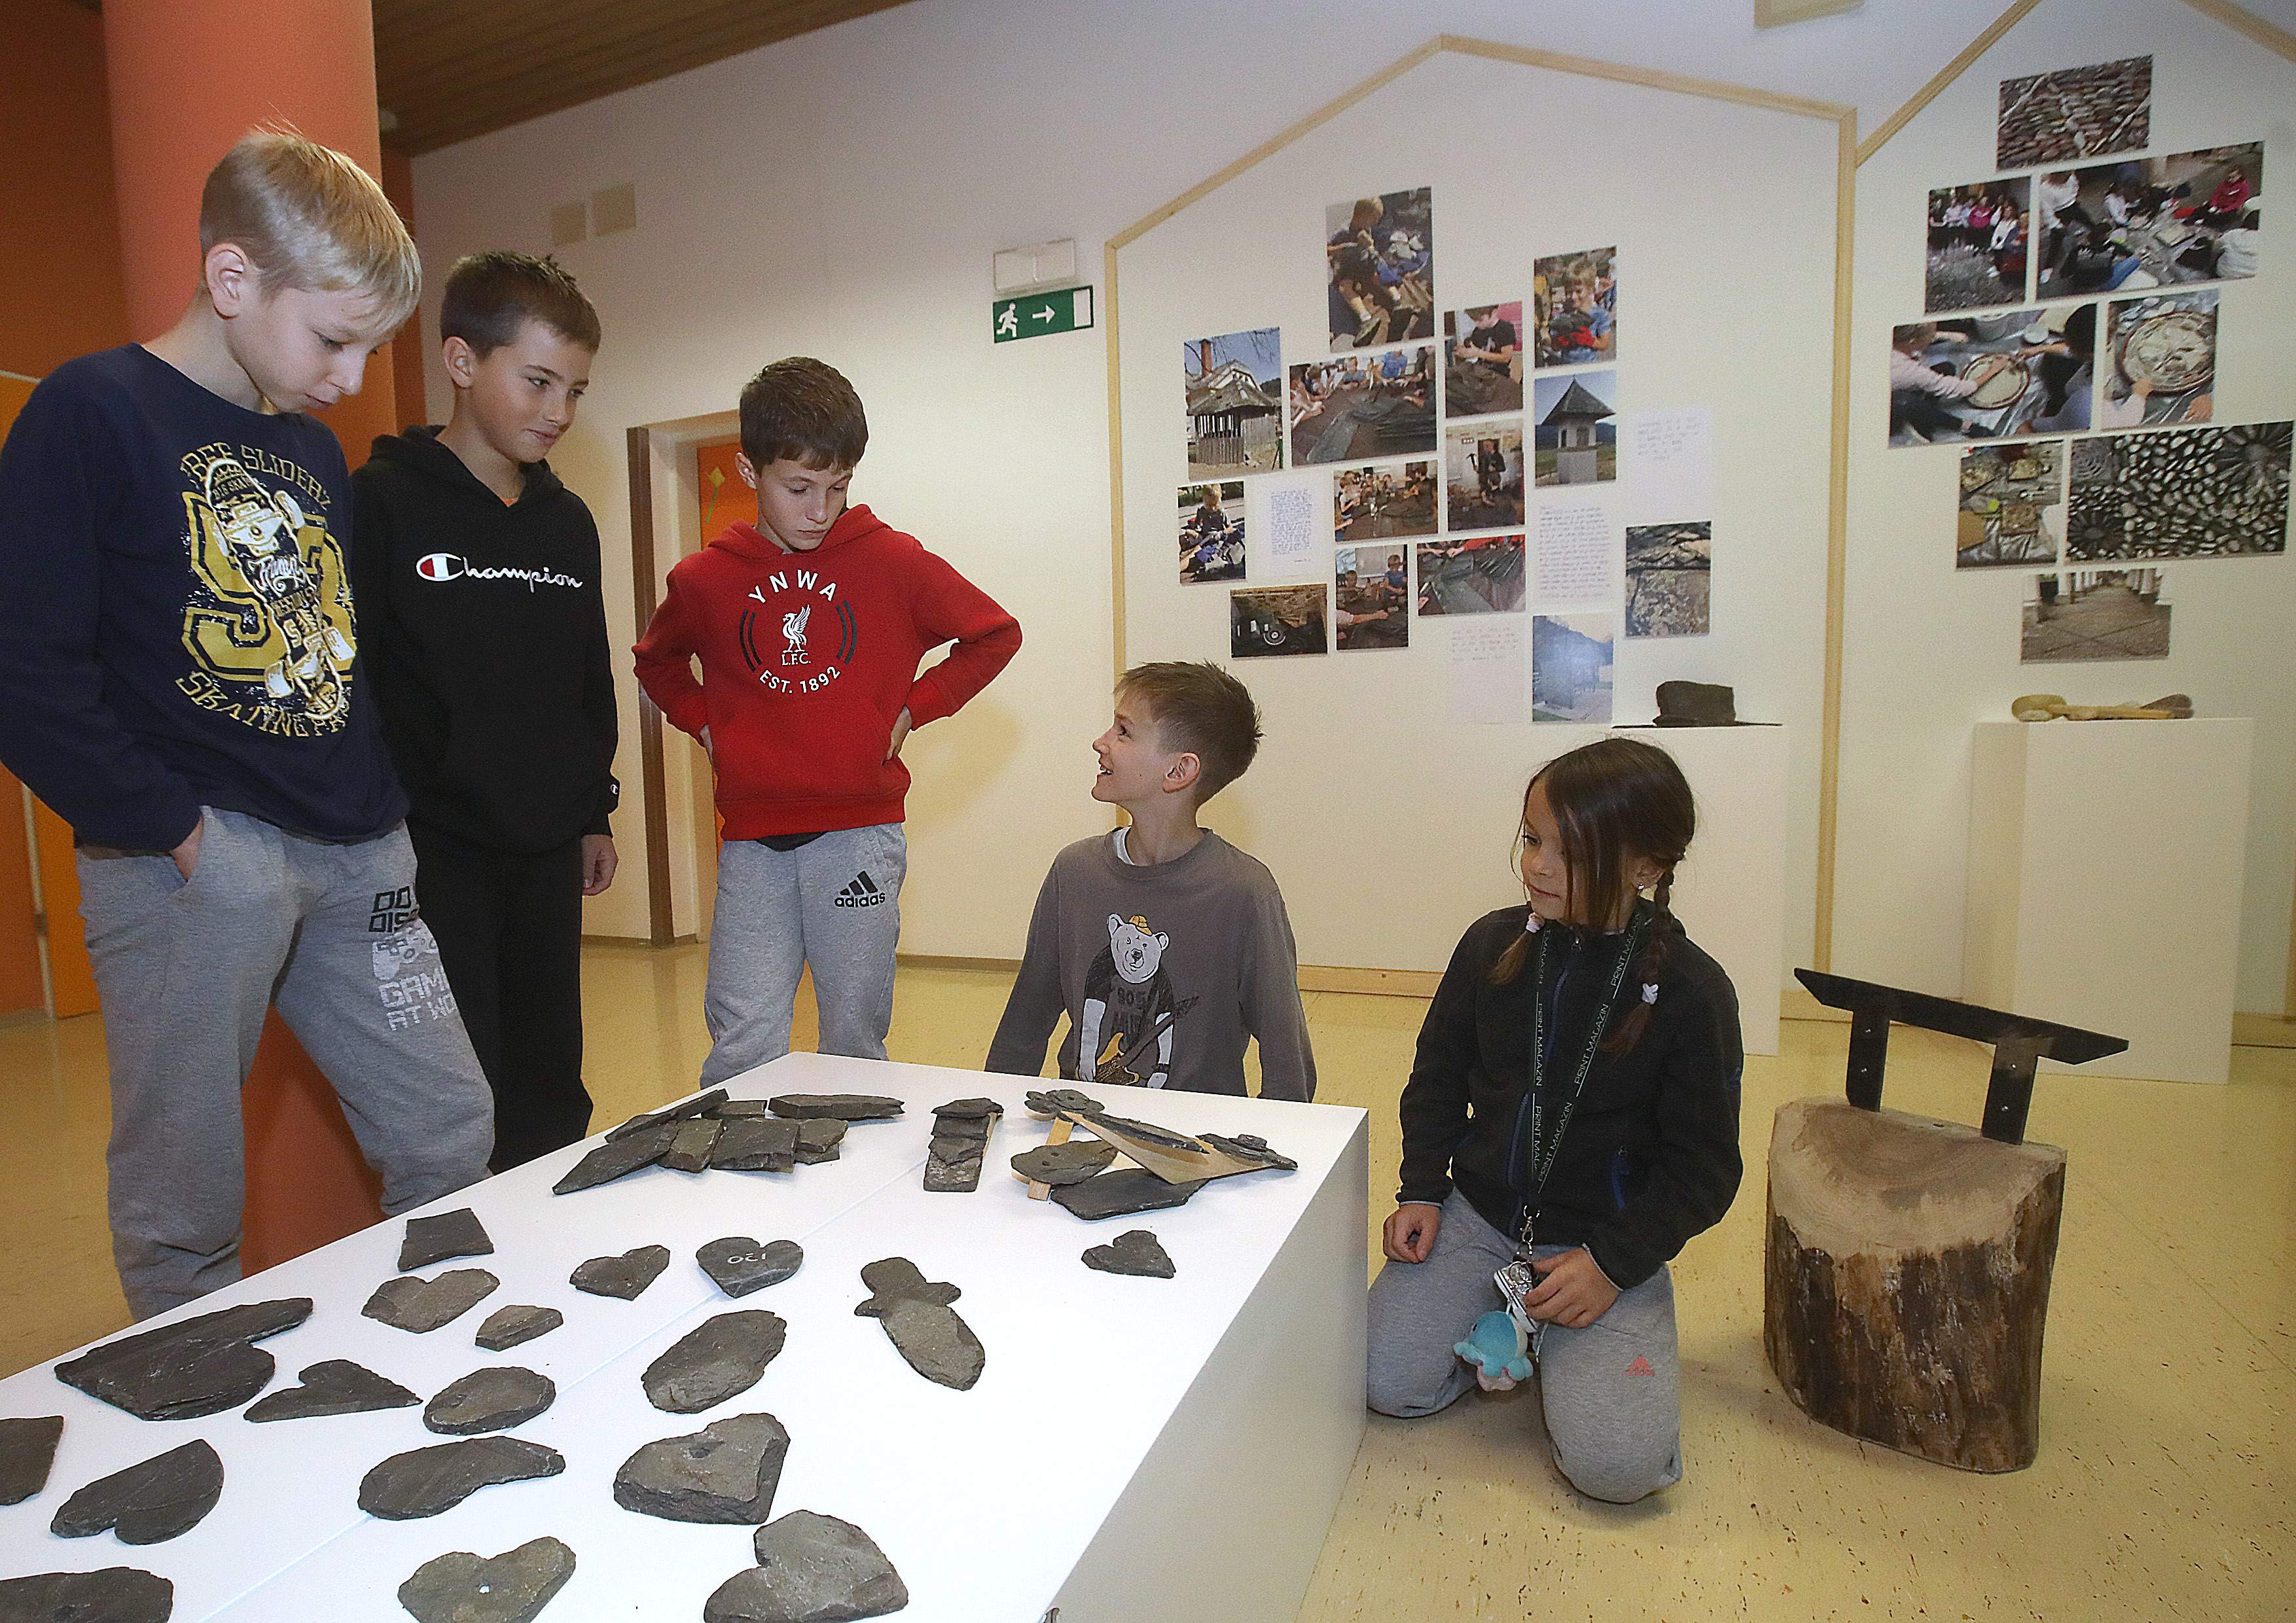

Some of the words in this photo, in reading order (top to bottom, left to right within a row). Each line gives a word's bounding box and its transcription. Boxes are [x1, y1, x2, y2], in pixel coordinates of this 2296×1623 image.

[416, 553, 583, 593] Champion
[748, 569, 836, 603] YNWA
[781, 652, 812, 666] L.F.C.
[759, 669, 793, 694] EST.
[799, 666, 840, 694] 1892
[834, 892, 885, 908] adidas
[1611, 955, 1626, 986] PRINT
[1573, 1054, 1590, 1084] PRINT
[1586, 1003, 1609, 1052] MAGAZIN
[1538, 1152, 1552, 1182] PRINT
[1550, 1102, 1572, 1150] MAGAZIN
